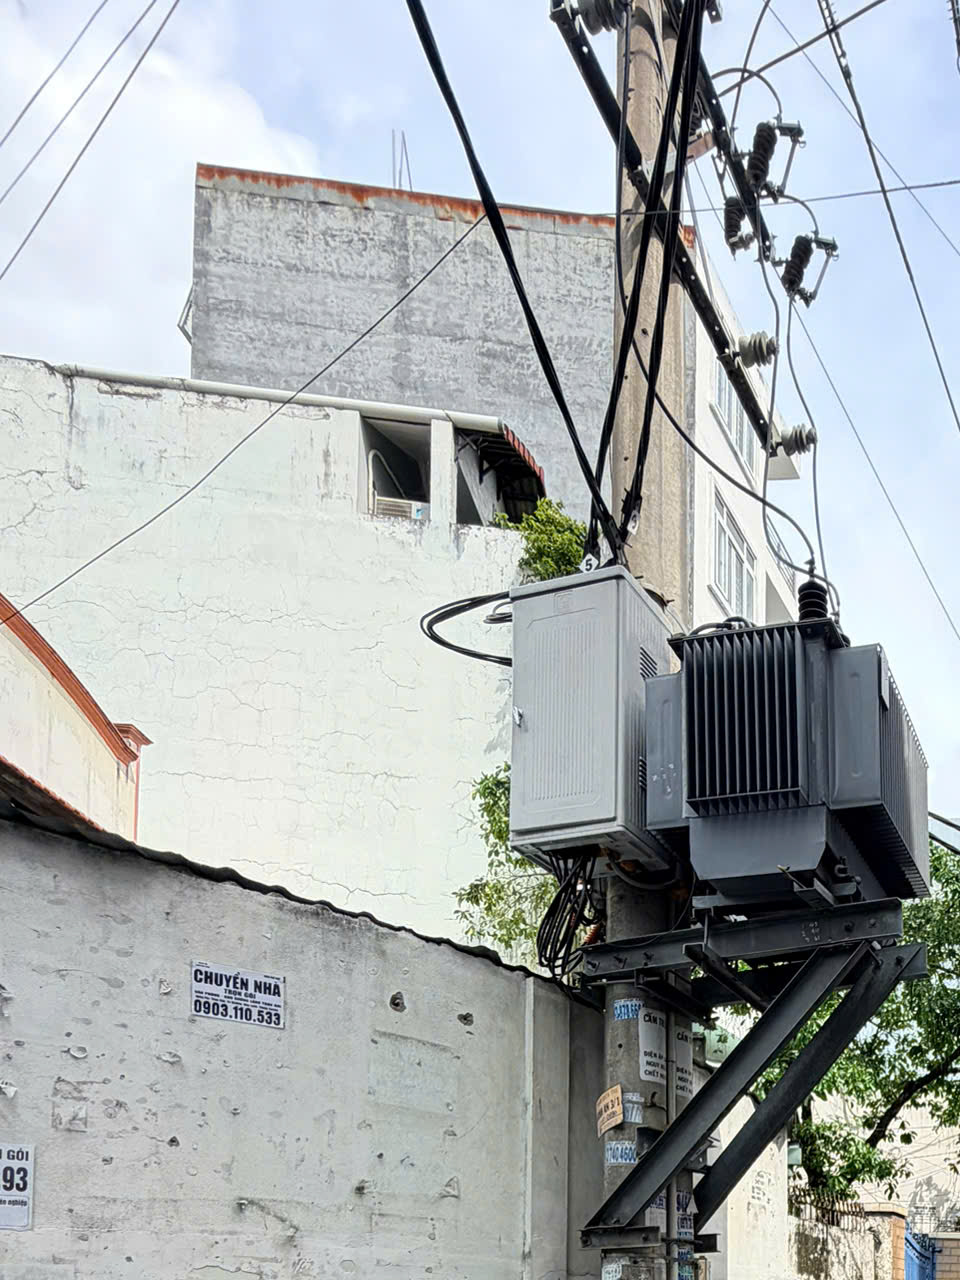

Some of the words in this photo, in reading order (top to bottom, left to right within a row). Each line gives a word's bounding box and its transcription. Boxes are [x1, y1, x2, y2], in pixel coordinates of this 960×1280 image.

[585, 559, 592, 571] 5
[194, 969, 249, 991] CHUYỂN
[254, 980, 281, 997] NHÀ
[244, 991, 256, 999] GÓI
[194, 999, 281, 1026] 0903.110.533
[6, 1147, 29, 1161] GÓI
